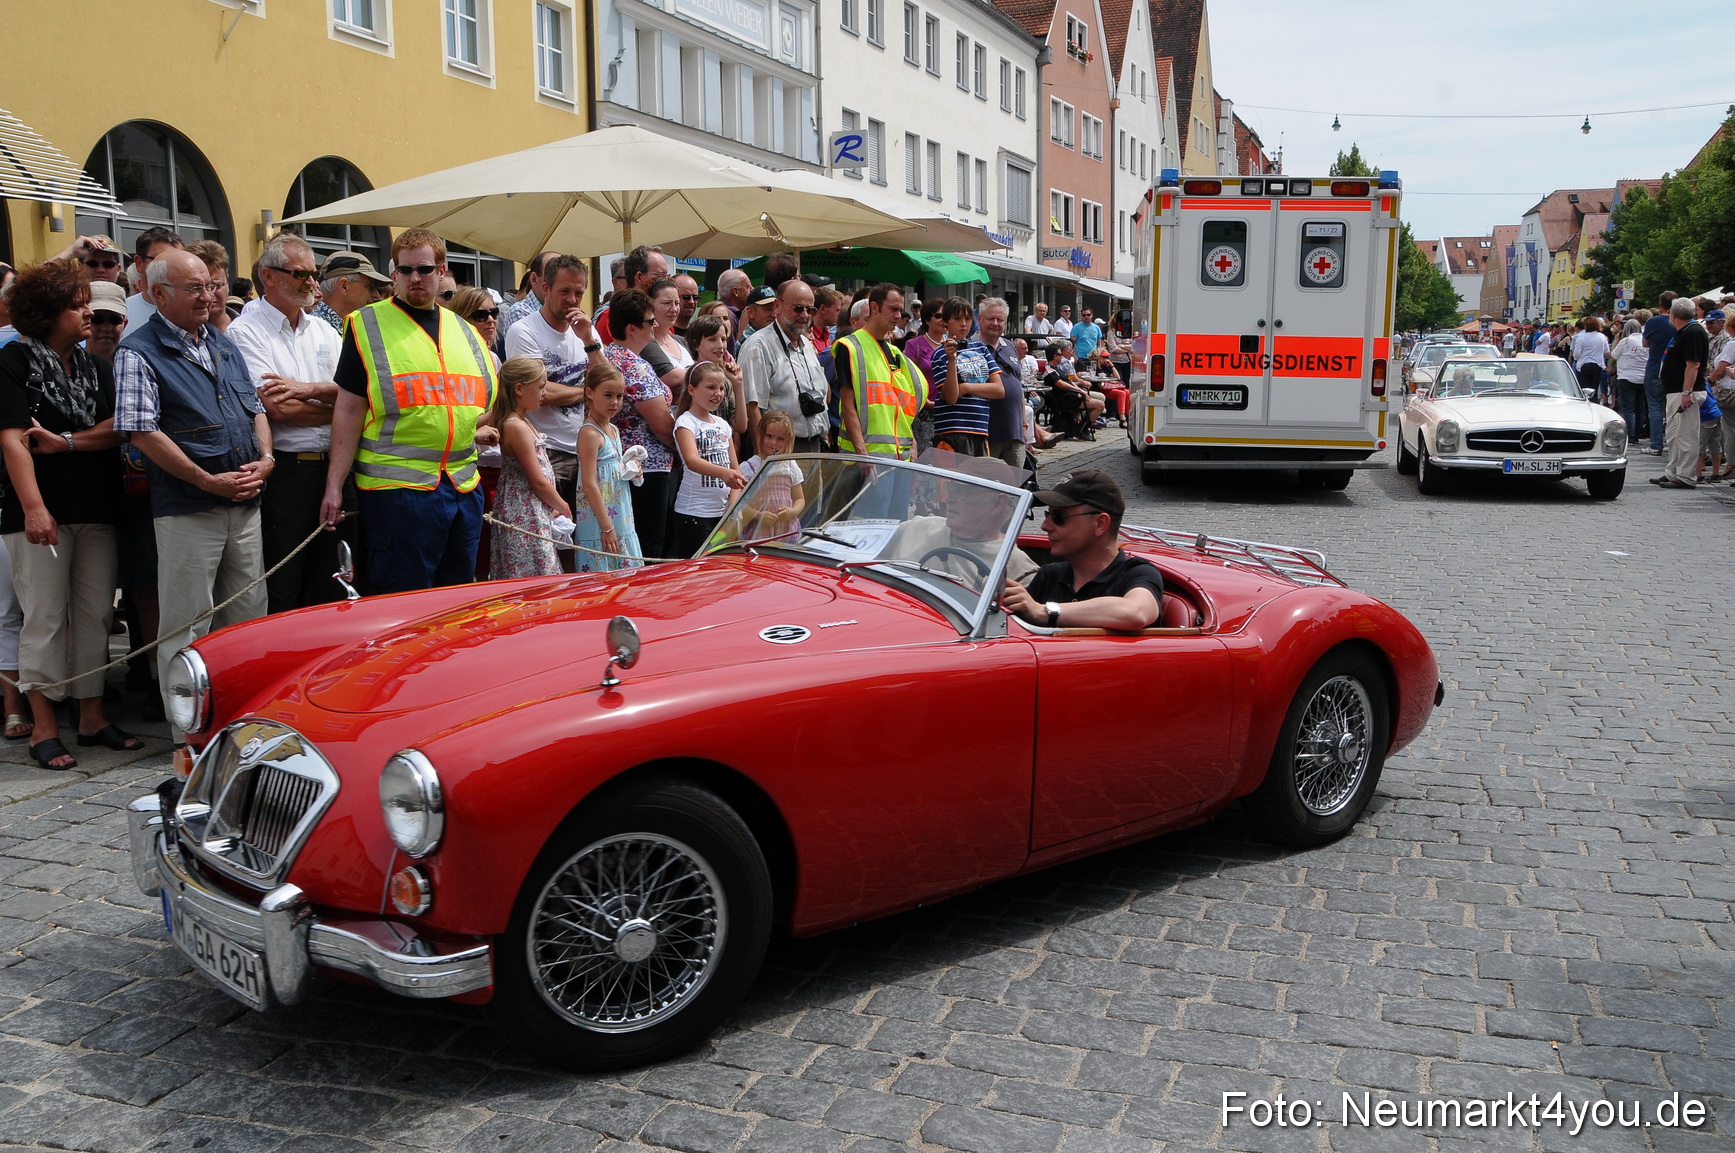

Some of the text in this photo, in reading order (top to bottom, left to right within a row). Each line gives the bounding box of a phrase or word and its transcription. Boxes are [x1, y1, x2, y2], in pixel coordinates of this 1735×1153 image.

[800, 259, 870, 267] mmsbräu
[1180, 352, 1357, 372] RETTUNGSDIENST
[394, 374, 476, 405] THW
[1188, 391, 1241, 401] NM RK 710
[1511, 461, 1559, 471] NM SL 3H
[193, 922, 217, 971] GA
[220, 942, 260, 998] 62H
